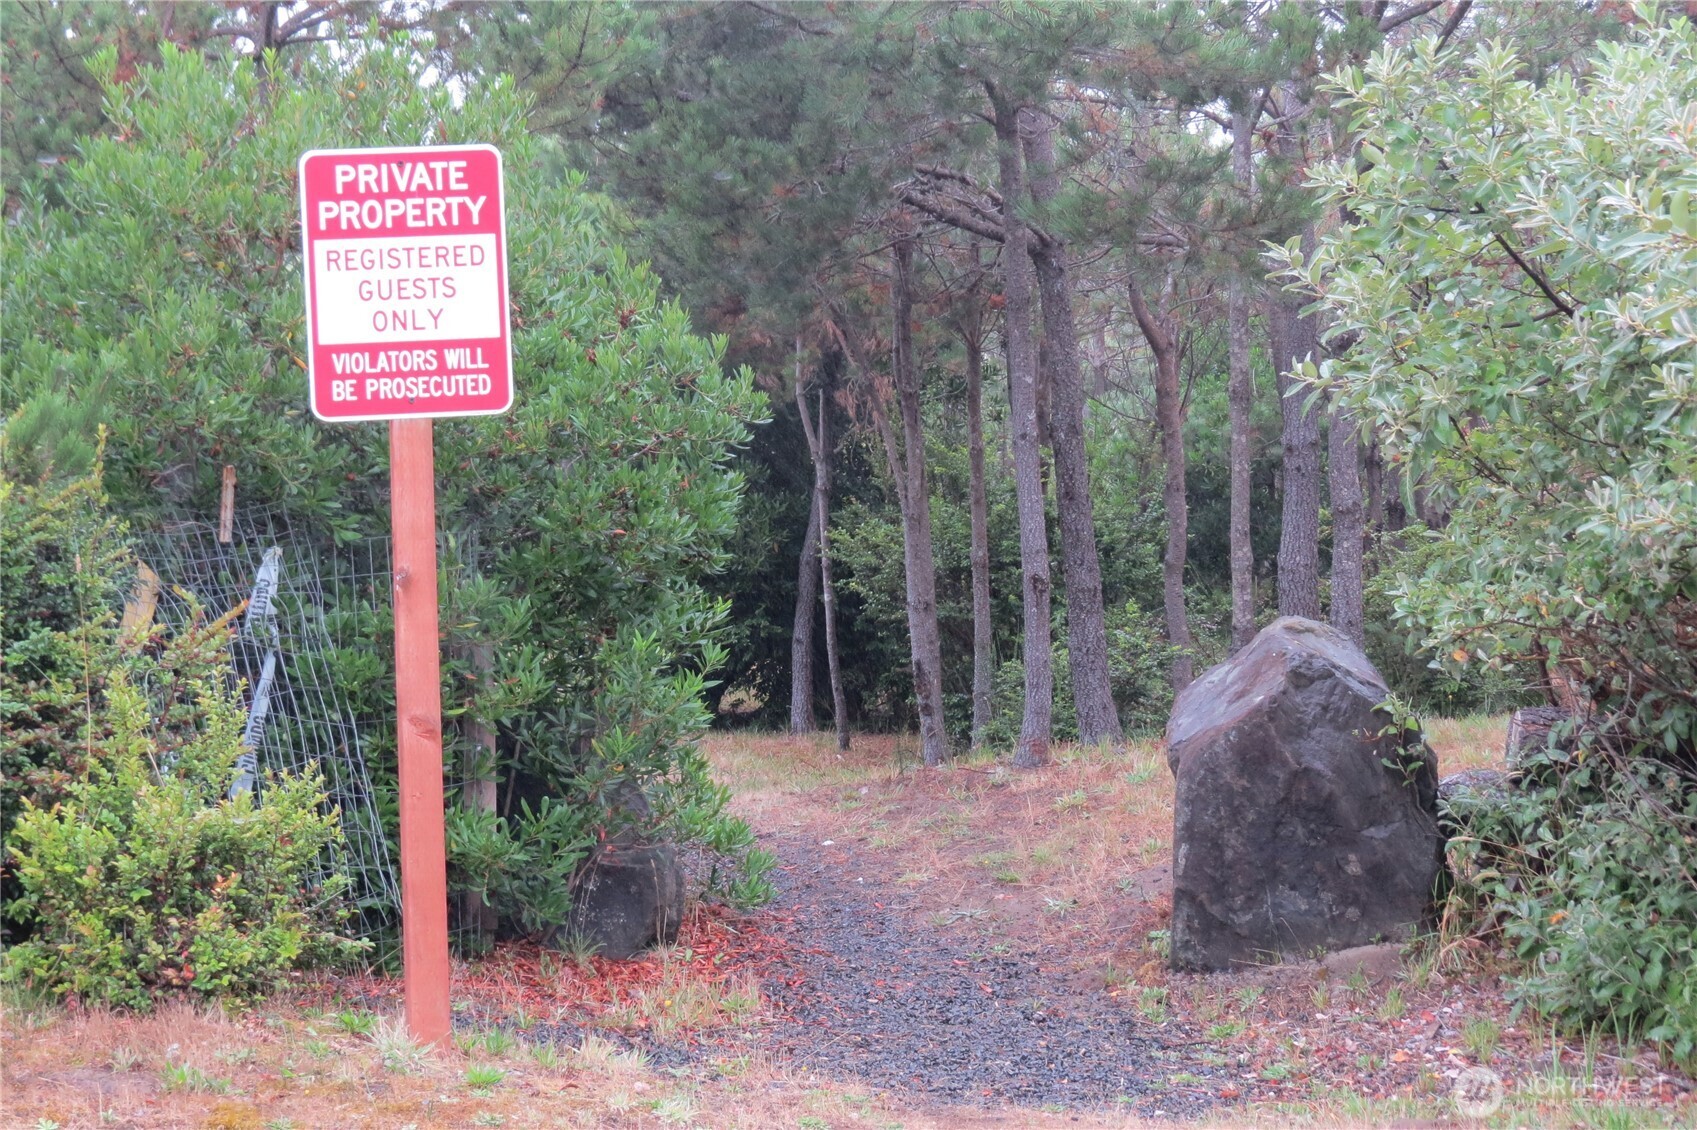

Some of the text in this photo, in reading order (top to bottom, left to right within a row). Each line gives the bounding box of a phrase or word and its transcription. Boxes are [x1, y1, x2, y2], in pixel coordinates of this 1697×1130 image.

[335, 161, 468, 194] PRIVATE
[318, 195, 487, 231] PROPERTY
[326, 244, 485, 271] REGISTERED
[358, 277, 457, 301] GUESTS
[372, 308, 444, 332] ONLY
[331, 347, 490, 374] VIOLATORS WILL
[331, 374, 492, 402] BE PROSECUTED
